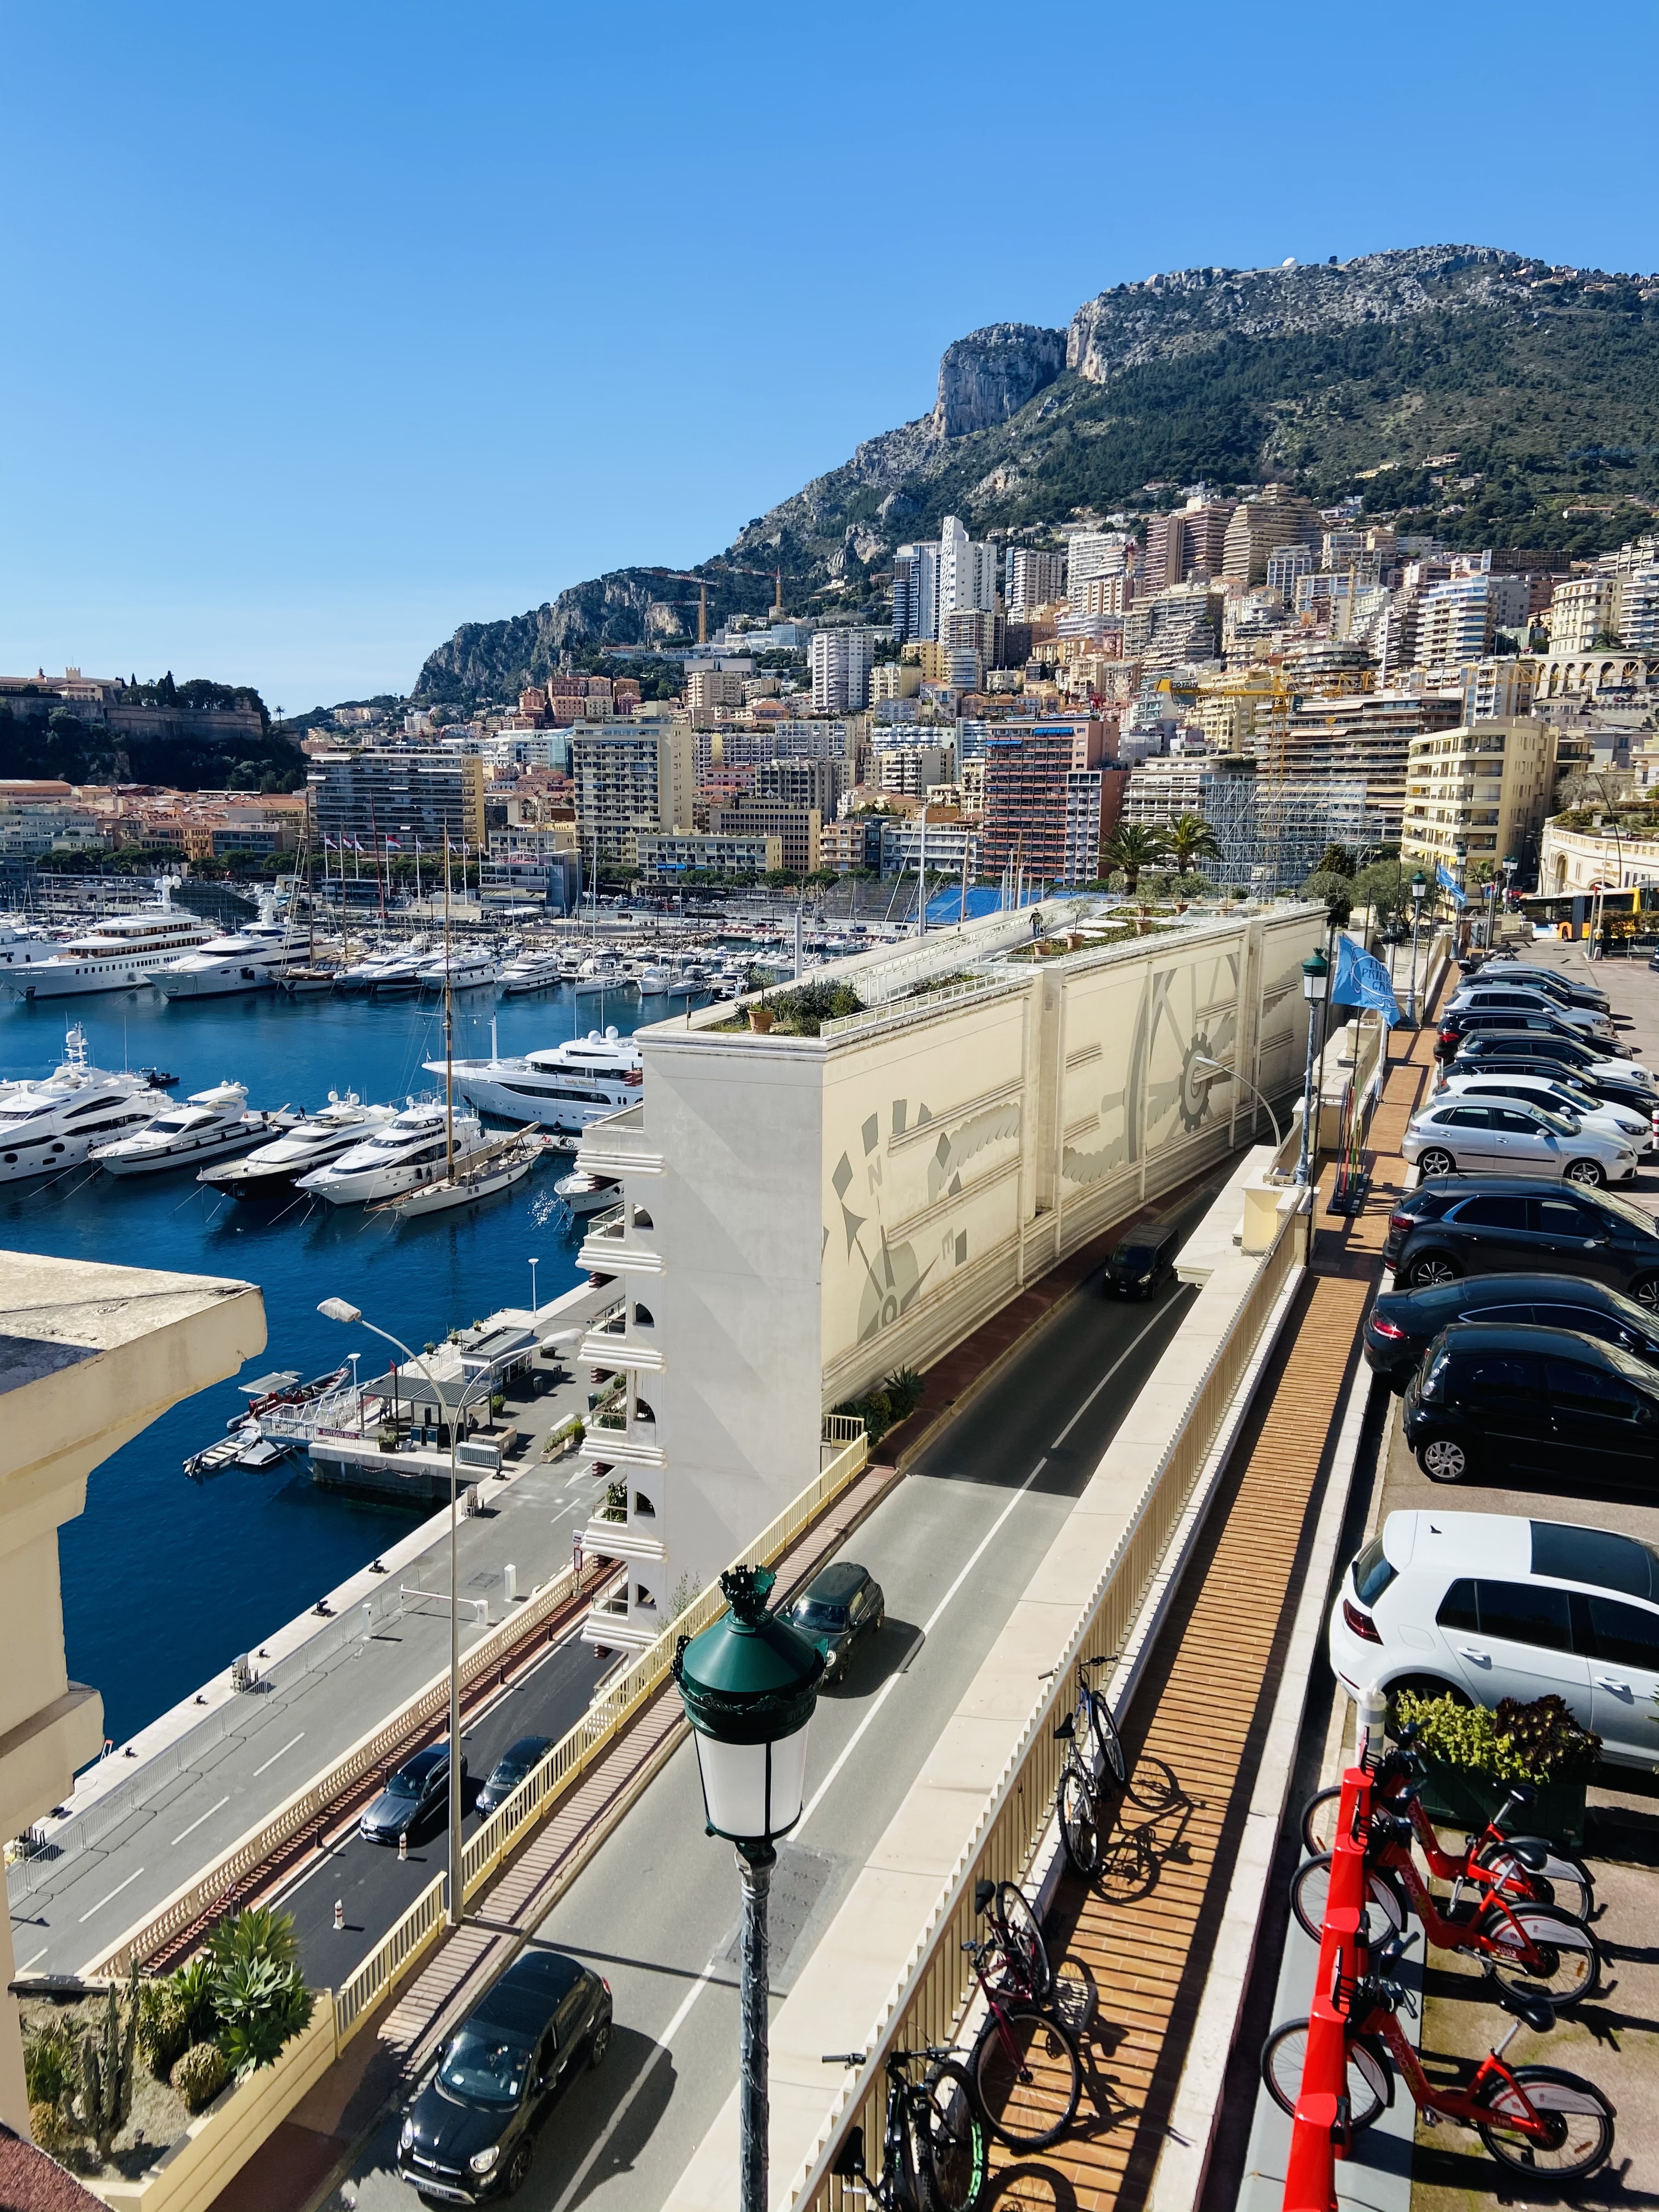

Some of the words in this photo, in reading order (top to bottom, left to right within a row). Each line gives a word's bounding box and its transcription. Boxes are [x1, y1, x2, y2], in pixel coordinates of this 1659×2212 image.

[868, 1154, 882, 1196] N
[942, 1227, 953, 1260] E
[323, 1429, 343, 1437] BATEAU
[1496, 1945, 1517, 1959] 2002
